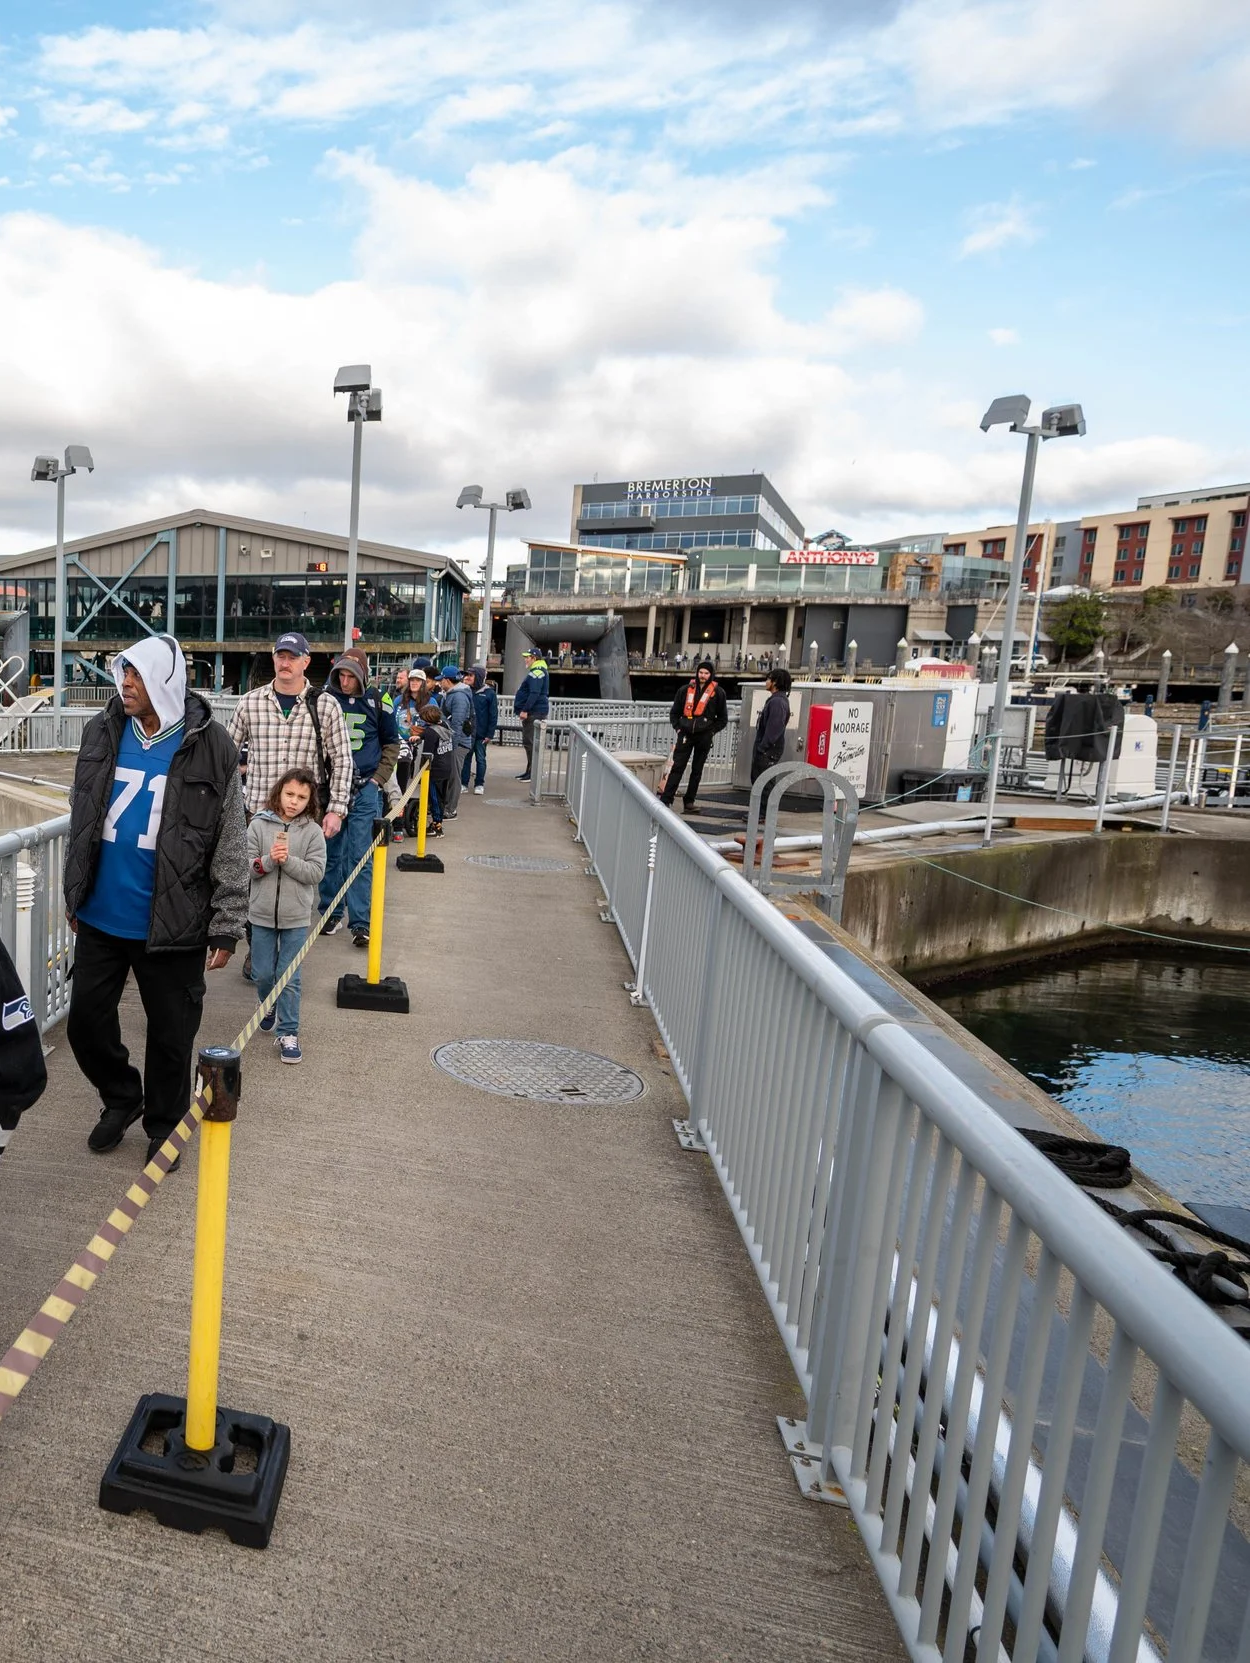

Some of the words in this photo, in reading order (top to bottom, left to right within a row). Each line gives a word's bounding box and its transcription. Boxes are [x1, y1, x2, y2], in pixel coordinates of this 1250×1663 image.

[627, 478, 712, 493] BREMERTON
[627, 488, 711, 500] HARBORSIDE
[786, 551, 875, 564] ANTHONY'S
[848, 708, 860, 719] NO
[833, 723, 870, 733] MOORAGE
[102, 766, 167, 850] 71
